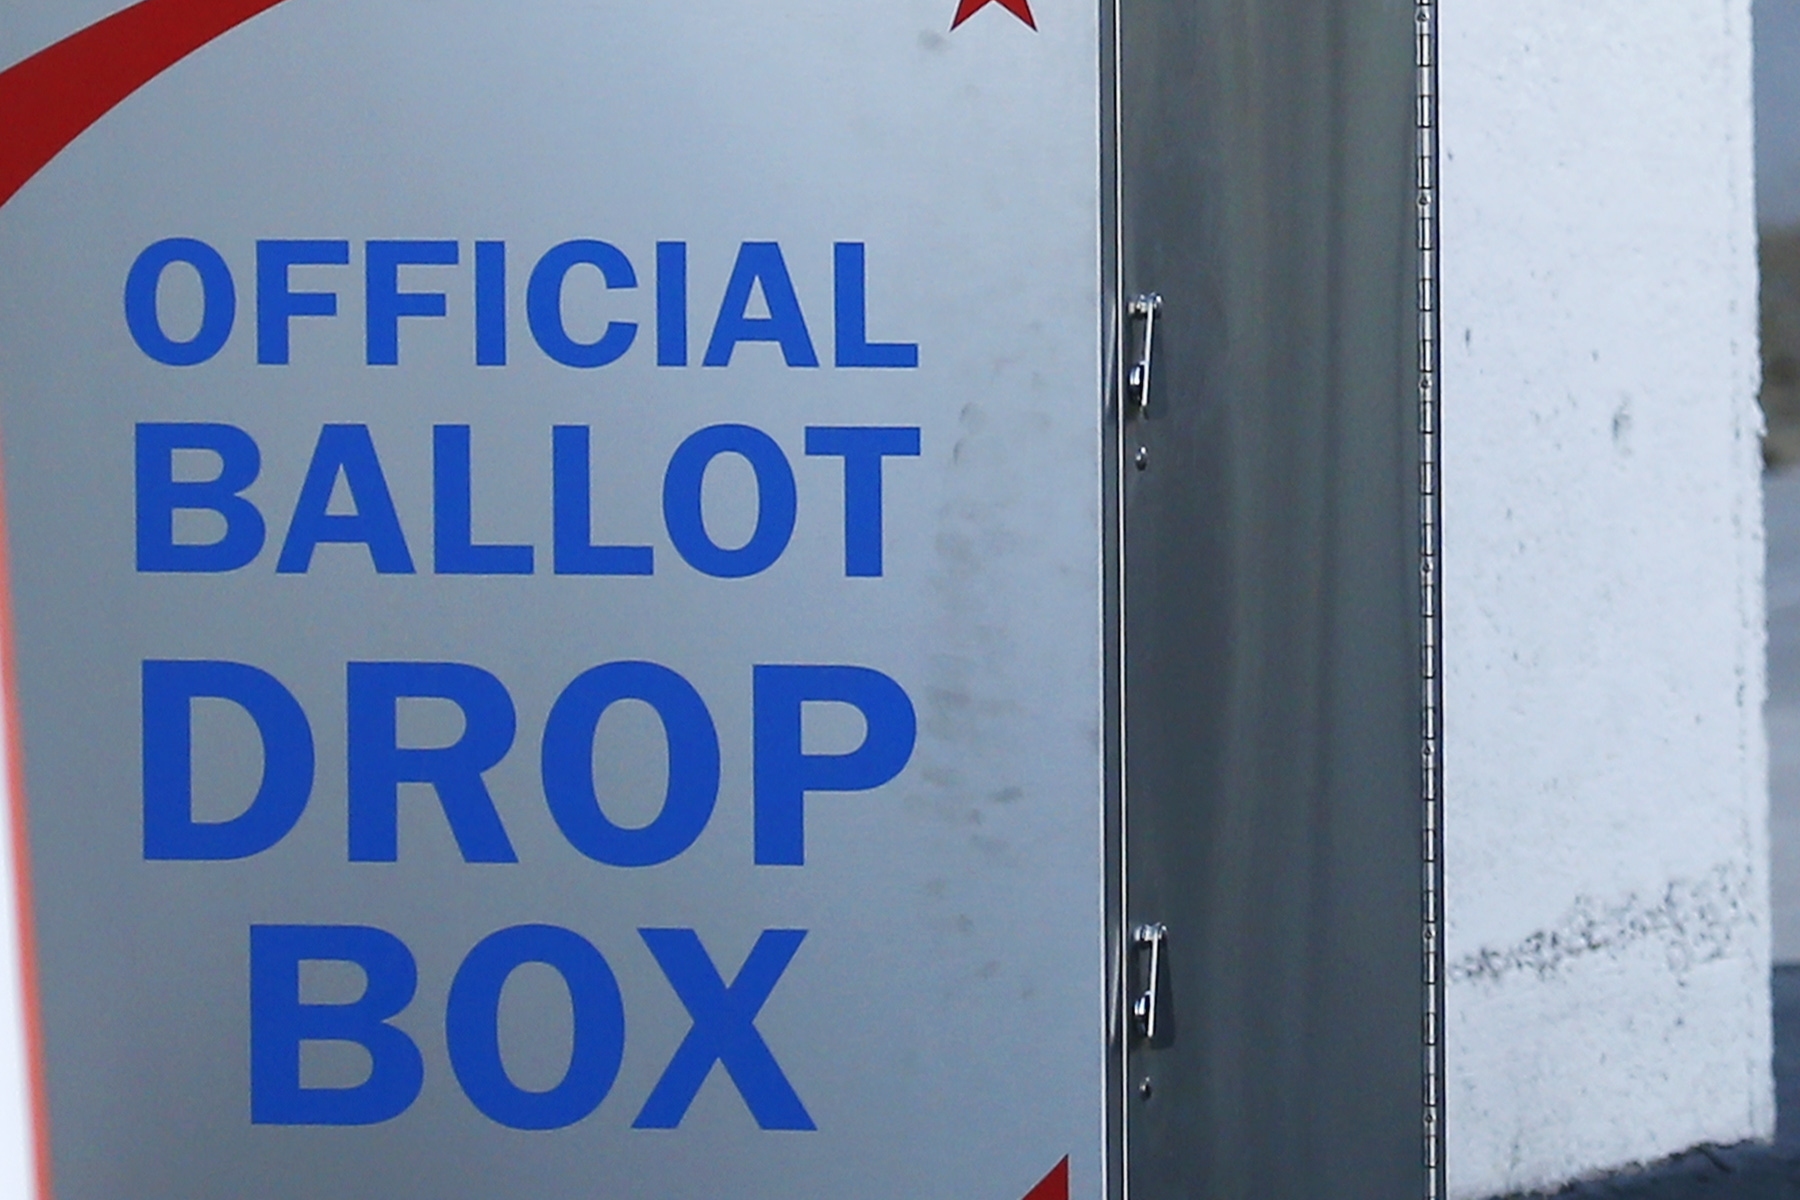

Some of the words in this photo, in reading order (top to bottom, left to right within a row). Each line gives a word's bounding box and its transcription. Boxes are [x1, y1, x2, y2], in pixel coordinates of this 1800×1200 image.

[123, 237, 919, 369] OFFICIAL
[134, 422, 922, 579] BALLOT
[141, 659, 918, 868] DROP
[249, 923, 818, 1132] BOX
